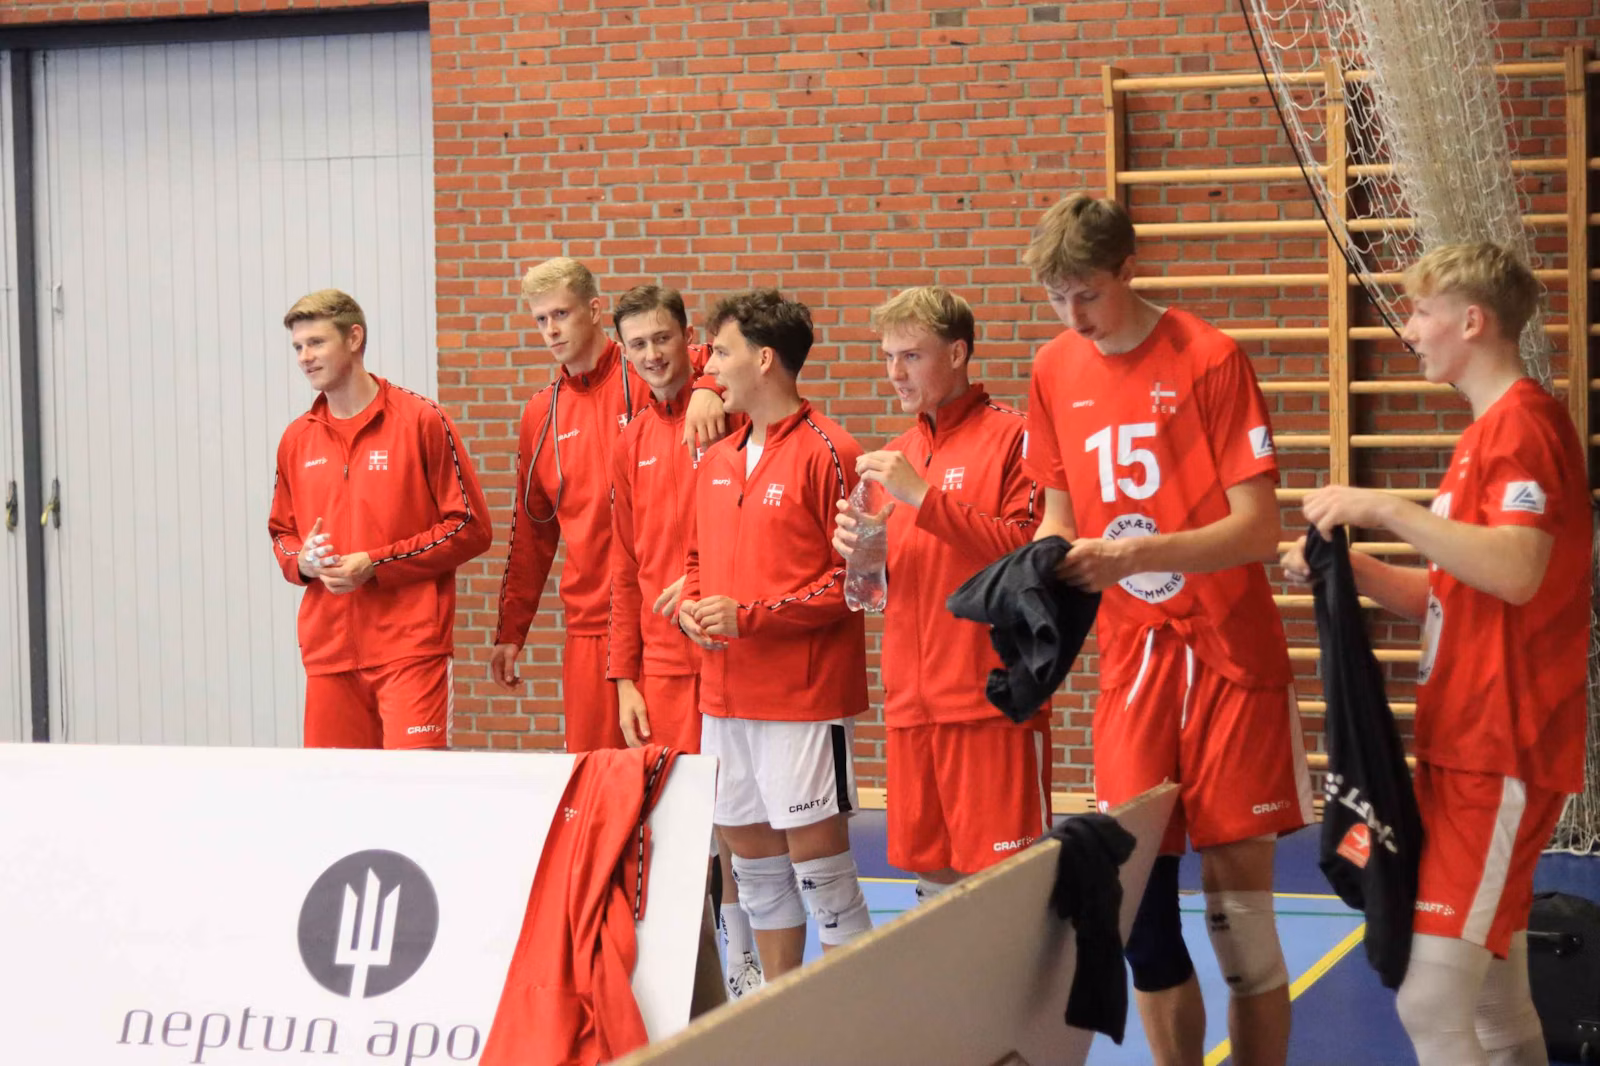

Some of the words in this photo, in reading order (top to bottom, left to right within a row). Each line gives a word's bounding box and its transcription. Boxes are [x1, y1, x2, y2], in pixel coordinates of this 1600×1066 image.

[1151, 405, 1176, 414] DEN
[1085, 422, 1161, 503] 15
[941, 483, 963, 491] DEN
[763, 497, 781, 507] DEN
[407, 724, 436, 734] CRAFT
[789, 799, 821, 813] CRAFT
[1252, 801, 1284, 815] CRAFT
[992, 837, 1026, 852] CRAFT
[1415, 901, 1444, 913] RAFT
[116, 1006, 339, 1065] neptun
[366, 1019, 481, 1066] apo
